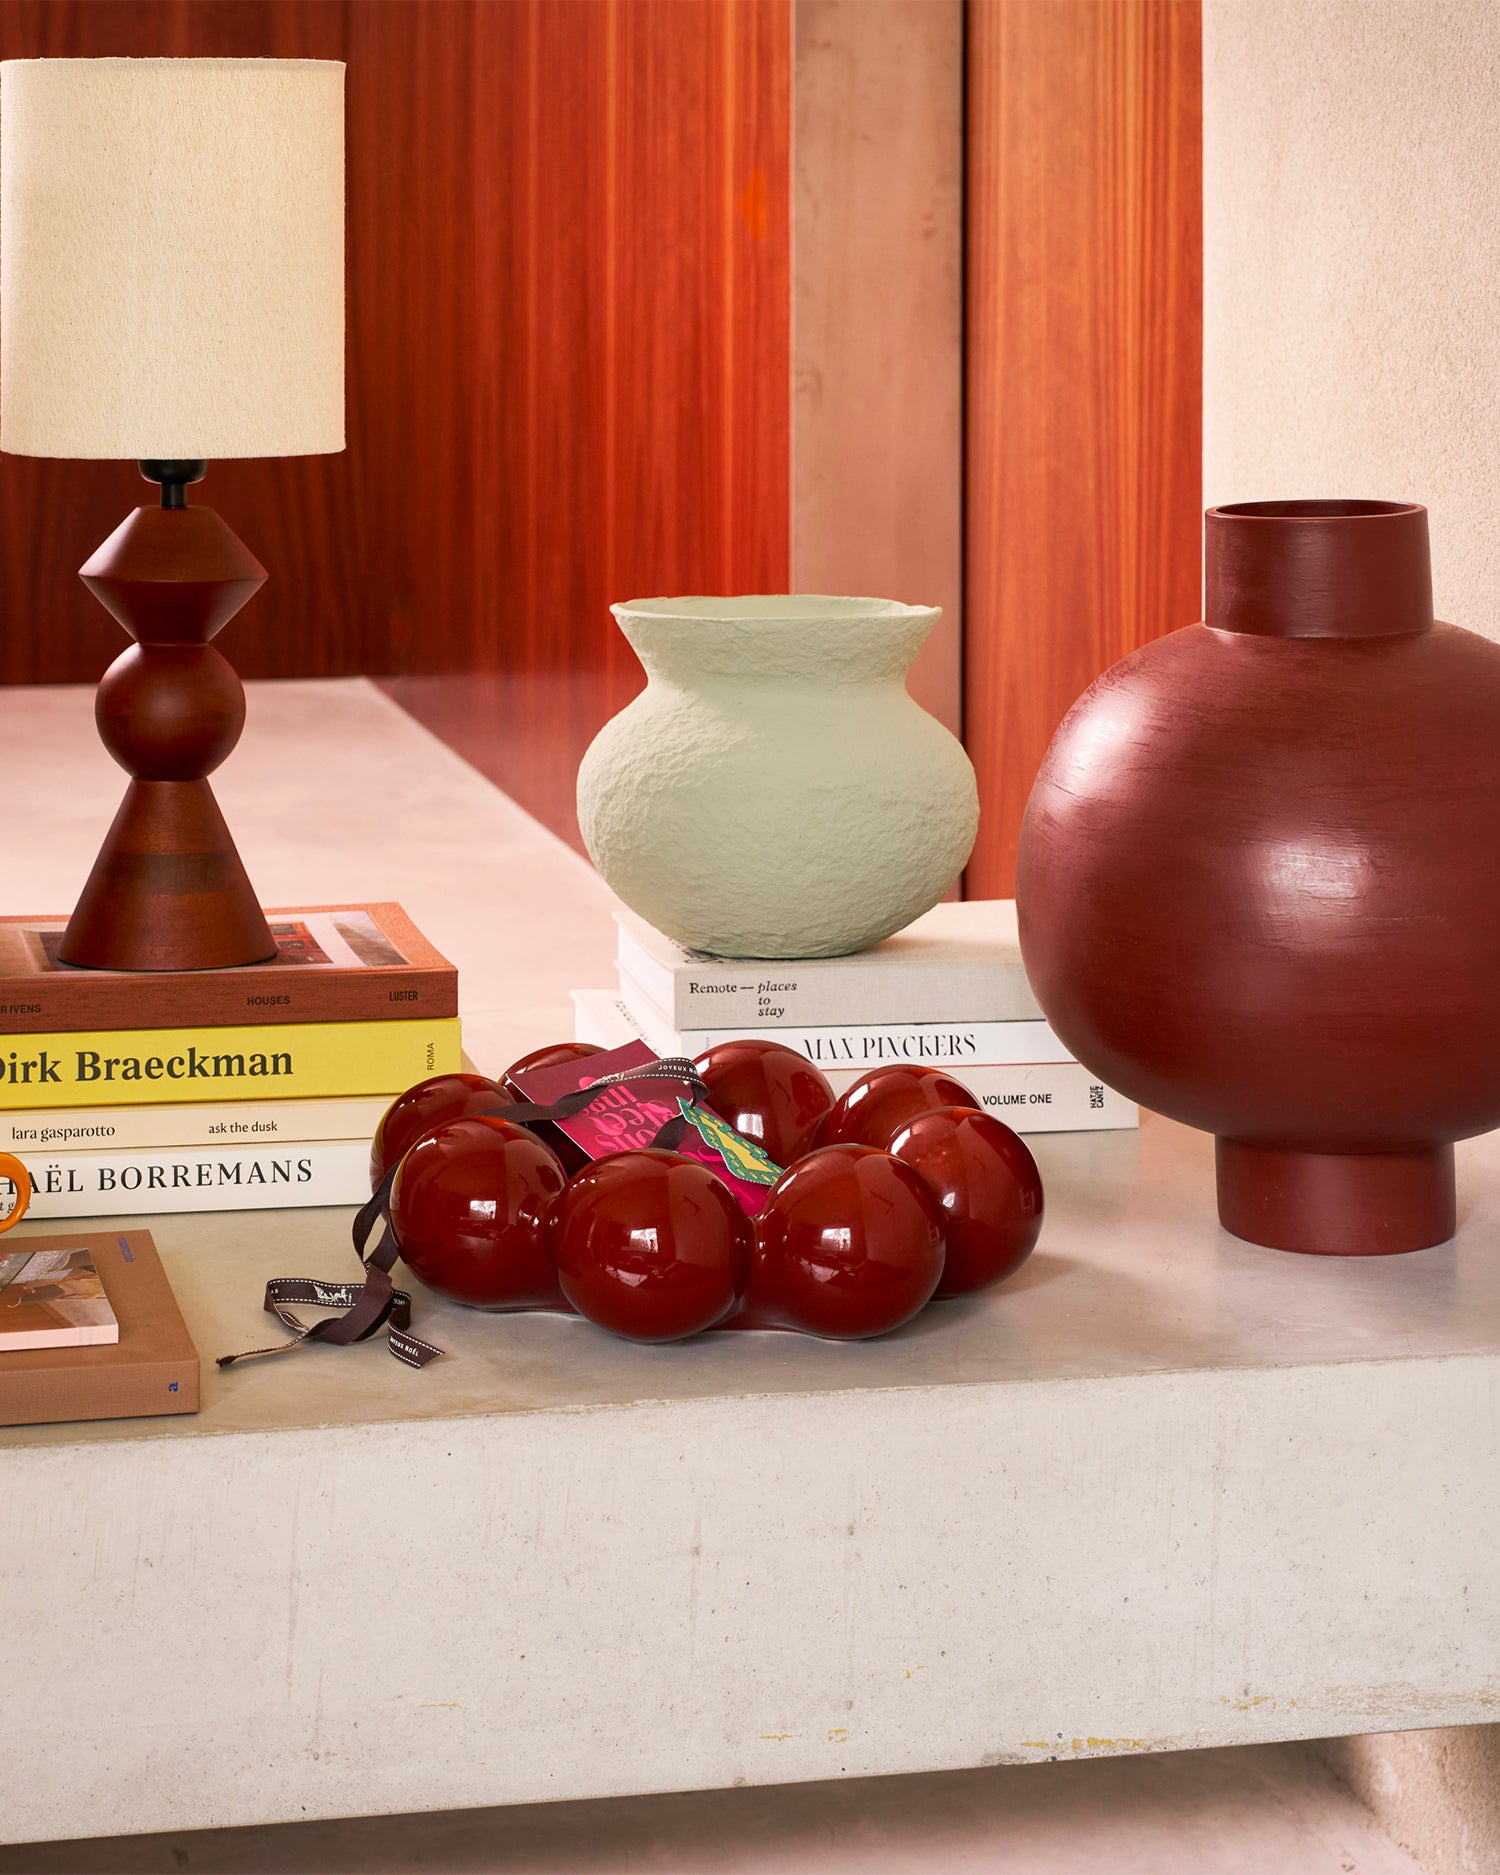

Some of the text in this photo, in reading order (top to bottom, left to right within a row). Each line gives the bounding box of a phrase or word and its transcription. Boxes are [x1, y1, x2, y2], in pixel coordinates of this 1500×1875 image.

[689, 982, 737, 994] Remote
[757, 980, 798, 994] places
[247, 996, 291, 1006] HOUSES
[389, 991, 418, 1002] LUSTER
[758, 997, 771, 1006] to
[9, 1004, 42, 1014] IVENS
[758, 1007, 785, 1018] stay
[804, 1033, 976, 1060] MAX PINCKERS
[426, 1042, 435, 1071] ROMA
[75, 1047, 294, 1082] Braeckman
[982, 1093, 1052, 1105] VOLUME ONE
[12, 1125, 116, 1143] lara gasparotto
[208, 1120, 278, 1135] ask the dusk
[97, 1158, 313, 1191] BORREMANS
